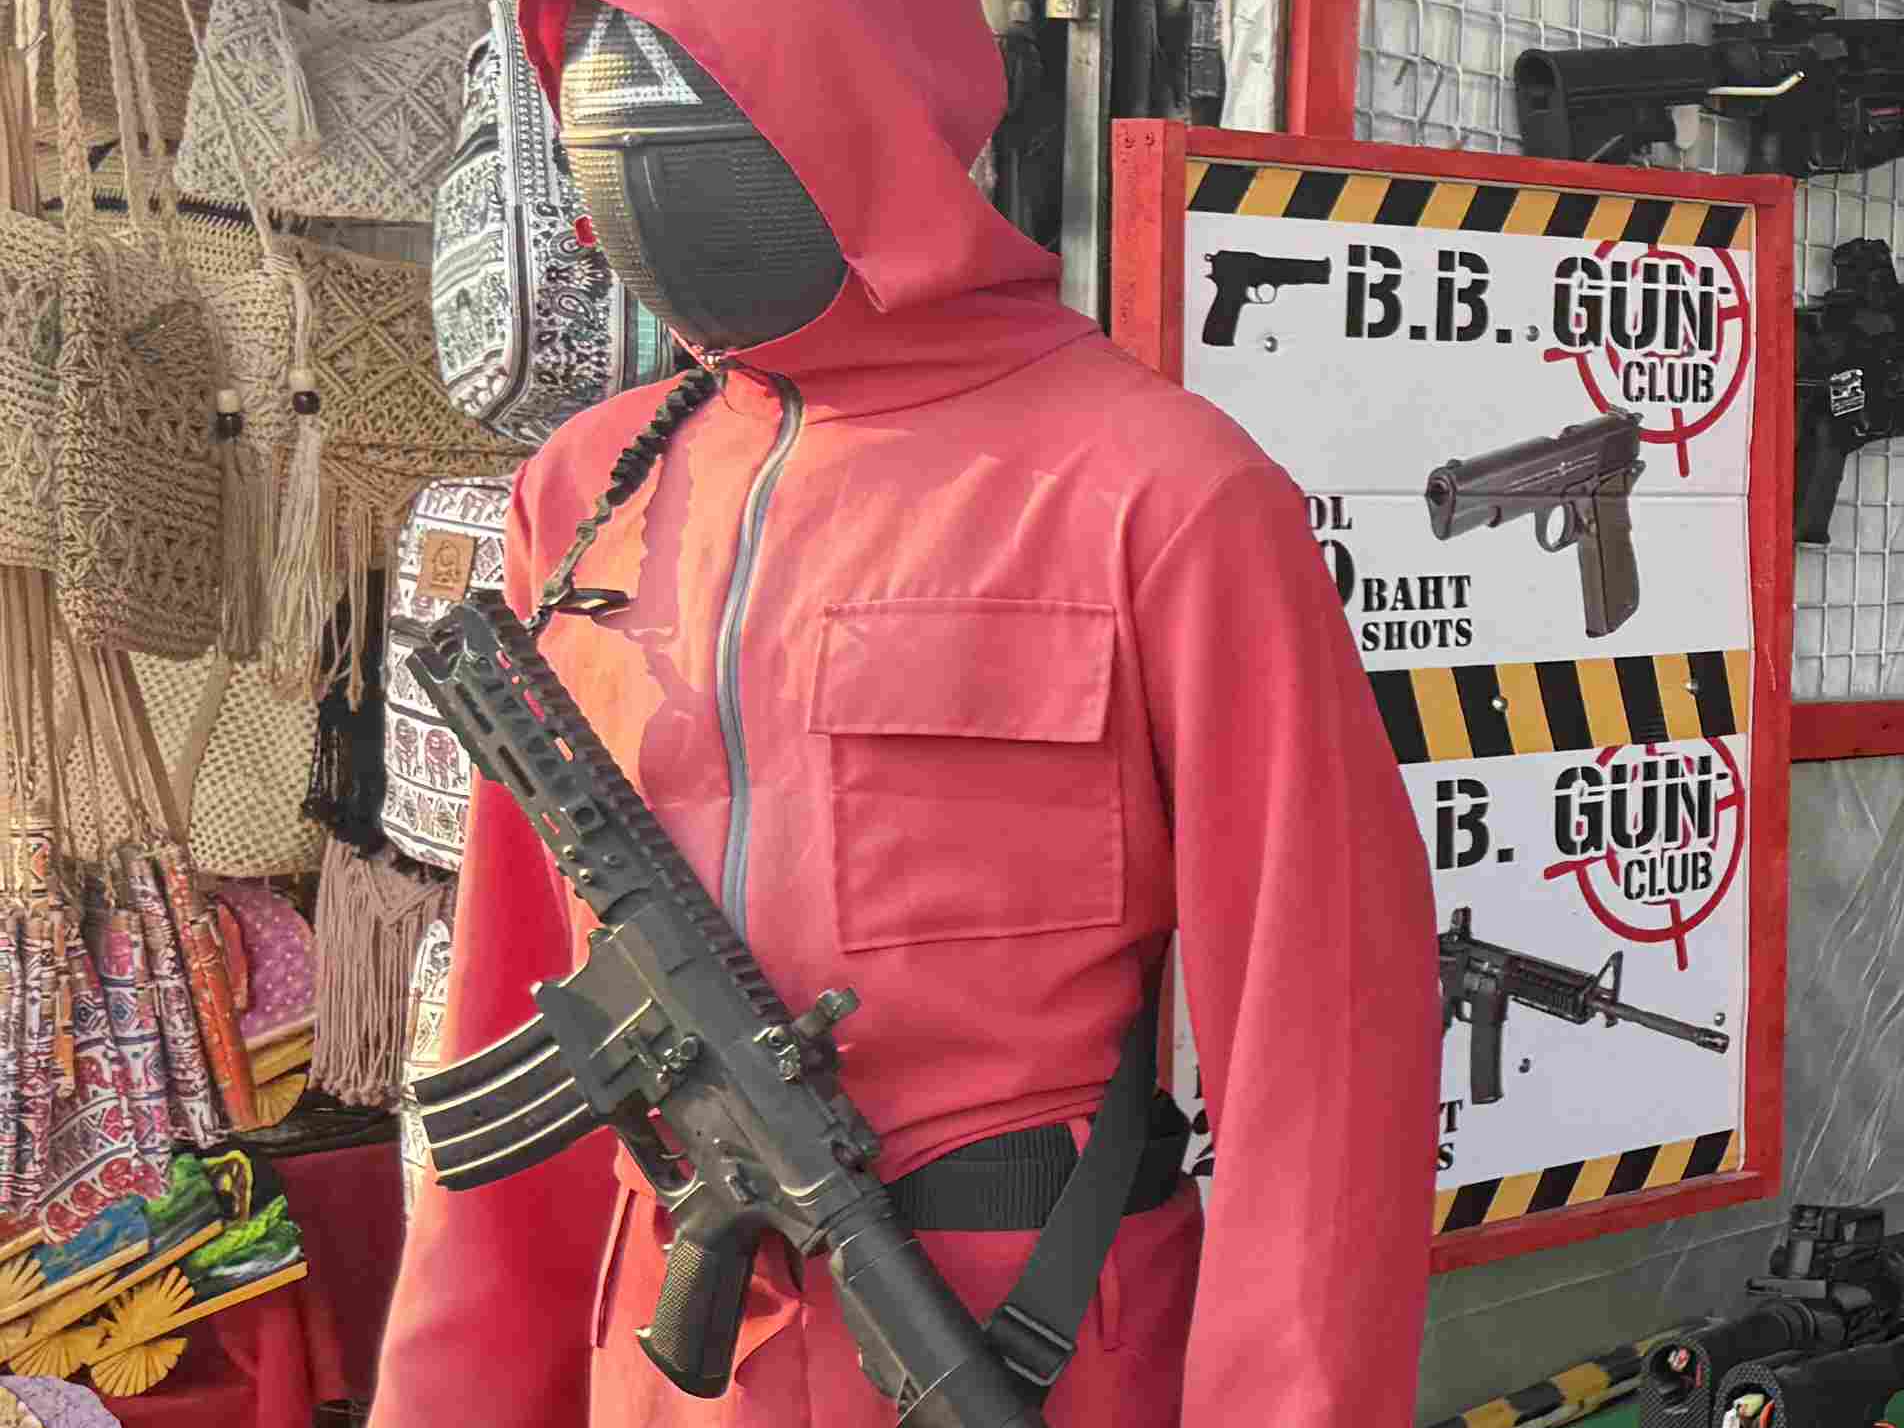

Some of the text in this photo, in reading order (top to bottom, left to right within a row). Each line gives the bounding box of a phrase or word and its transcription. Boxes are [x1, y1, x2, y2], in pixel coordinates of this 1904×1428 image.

[1346, 245, 1714, 351] B.B. GUN
[1623, 361, 1714, 403] CLUB
[1362, 575, 1471, 612] BAHT
[1361, 618, 1473, 652] SHOTS
[1553, 754, 1714, 857] GUN
[1624, 850, 1712, 901] CLUB
